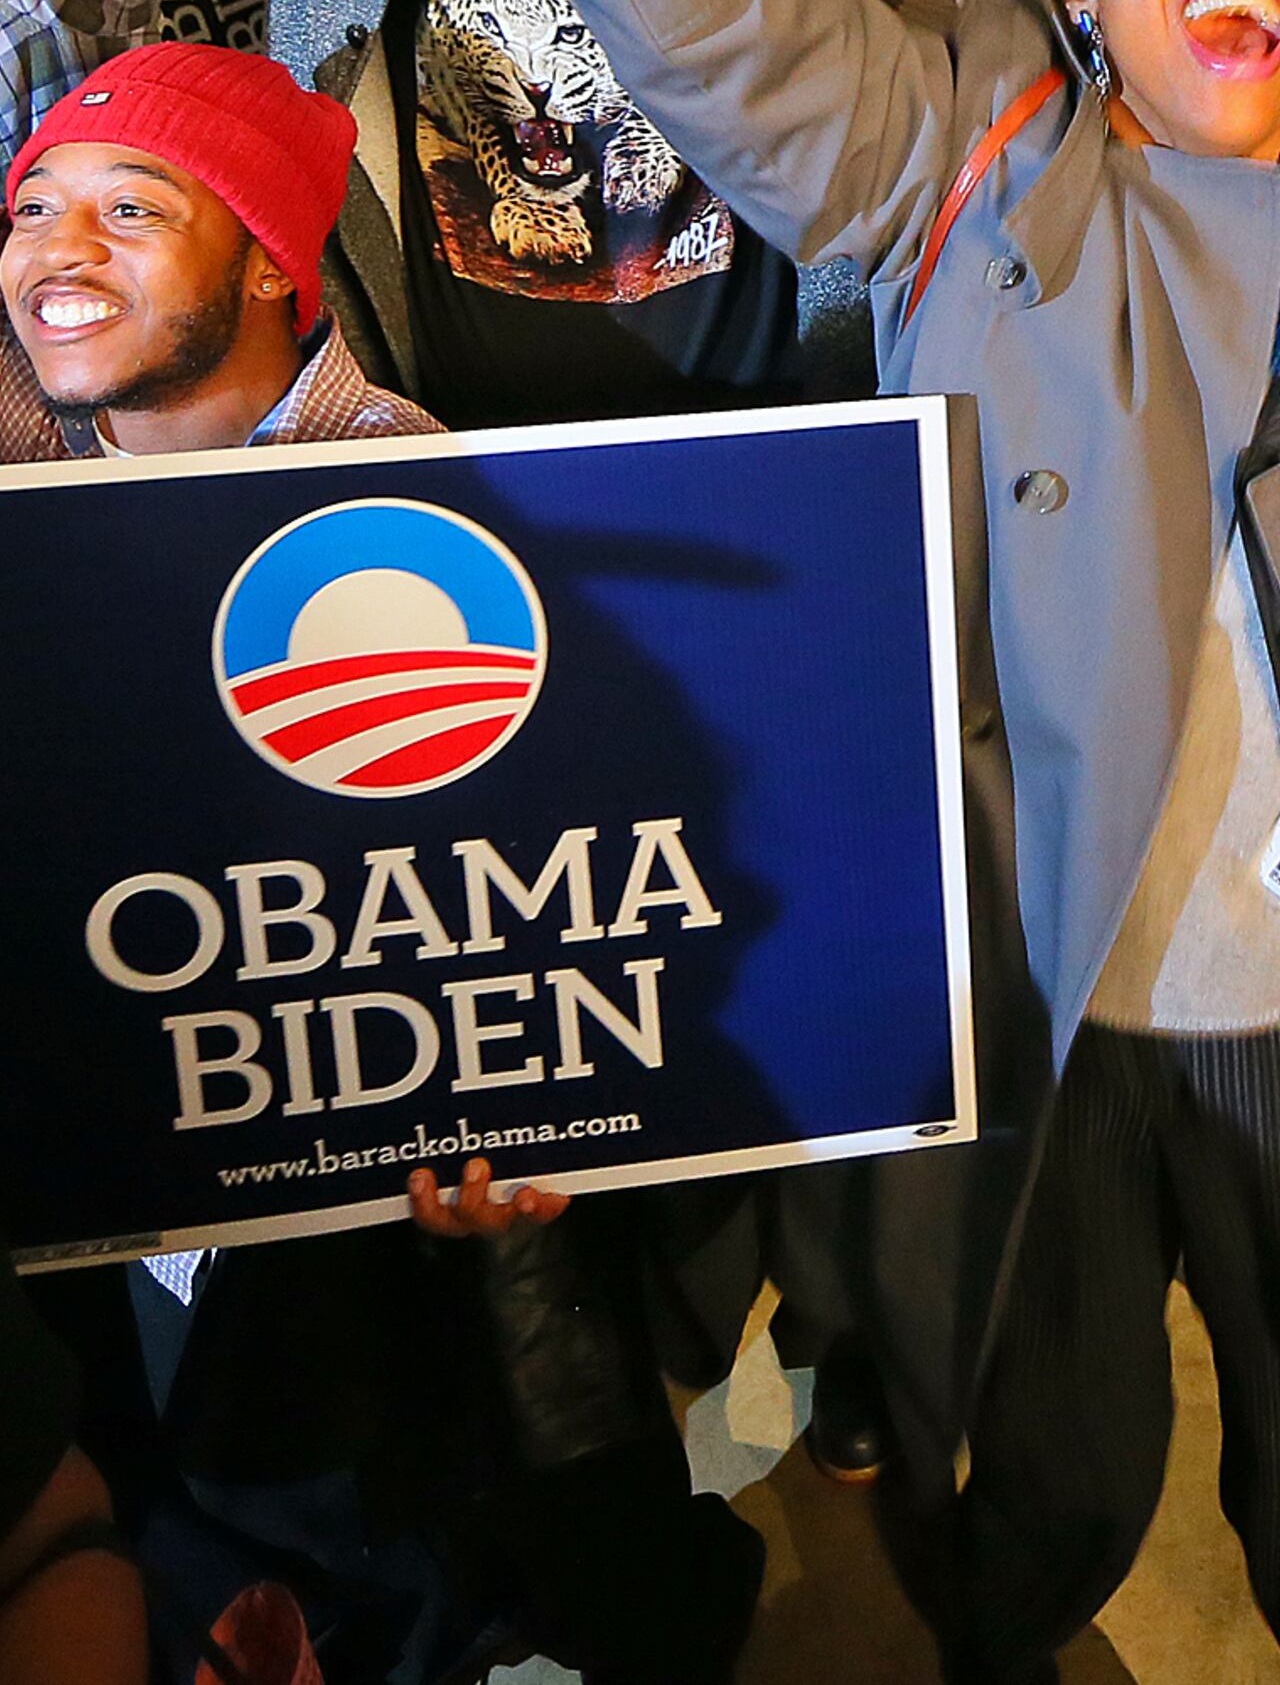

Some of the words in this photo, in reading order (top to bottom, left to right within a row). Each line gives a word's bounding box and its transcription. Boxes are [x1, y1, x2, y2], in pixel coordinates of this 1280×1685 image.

[664, 212, 728, 268] 1987
[84, 816, 721, 994] OBAMA
[161, 957, 666, 1133] BIDEN
[217, 1108, 642, 1189] www.barackobama.com
